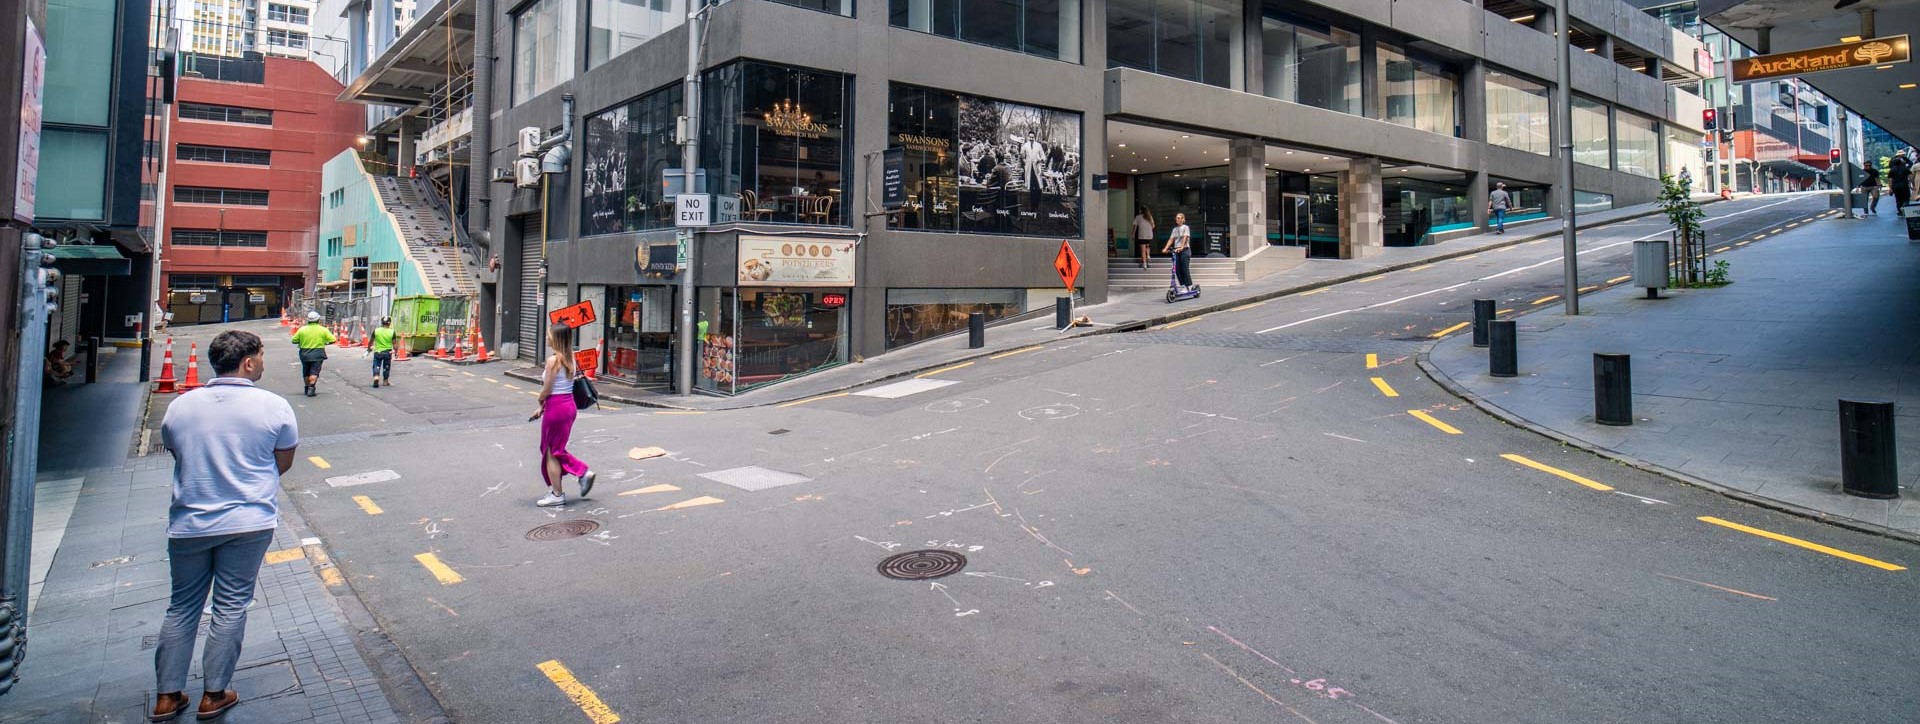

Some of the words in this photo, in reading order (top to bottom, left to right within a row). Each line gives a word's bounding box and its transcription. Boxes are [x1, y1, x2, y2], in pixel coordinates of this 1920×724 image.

[1746, 49, 1850, 76] Auckland
[766, 115, 829, 134] SWANSONS
[898, 133, 950, 147] SWANSONS
[685, 199, 700, 209] NO
[681, 211, 705, 221] EXIT
[782, 259, 834, 269] POTSTICKERS
